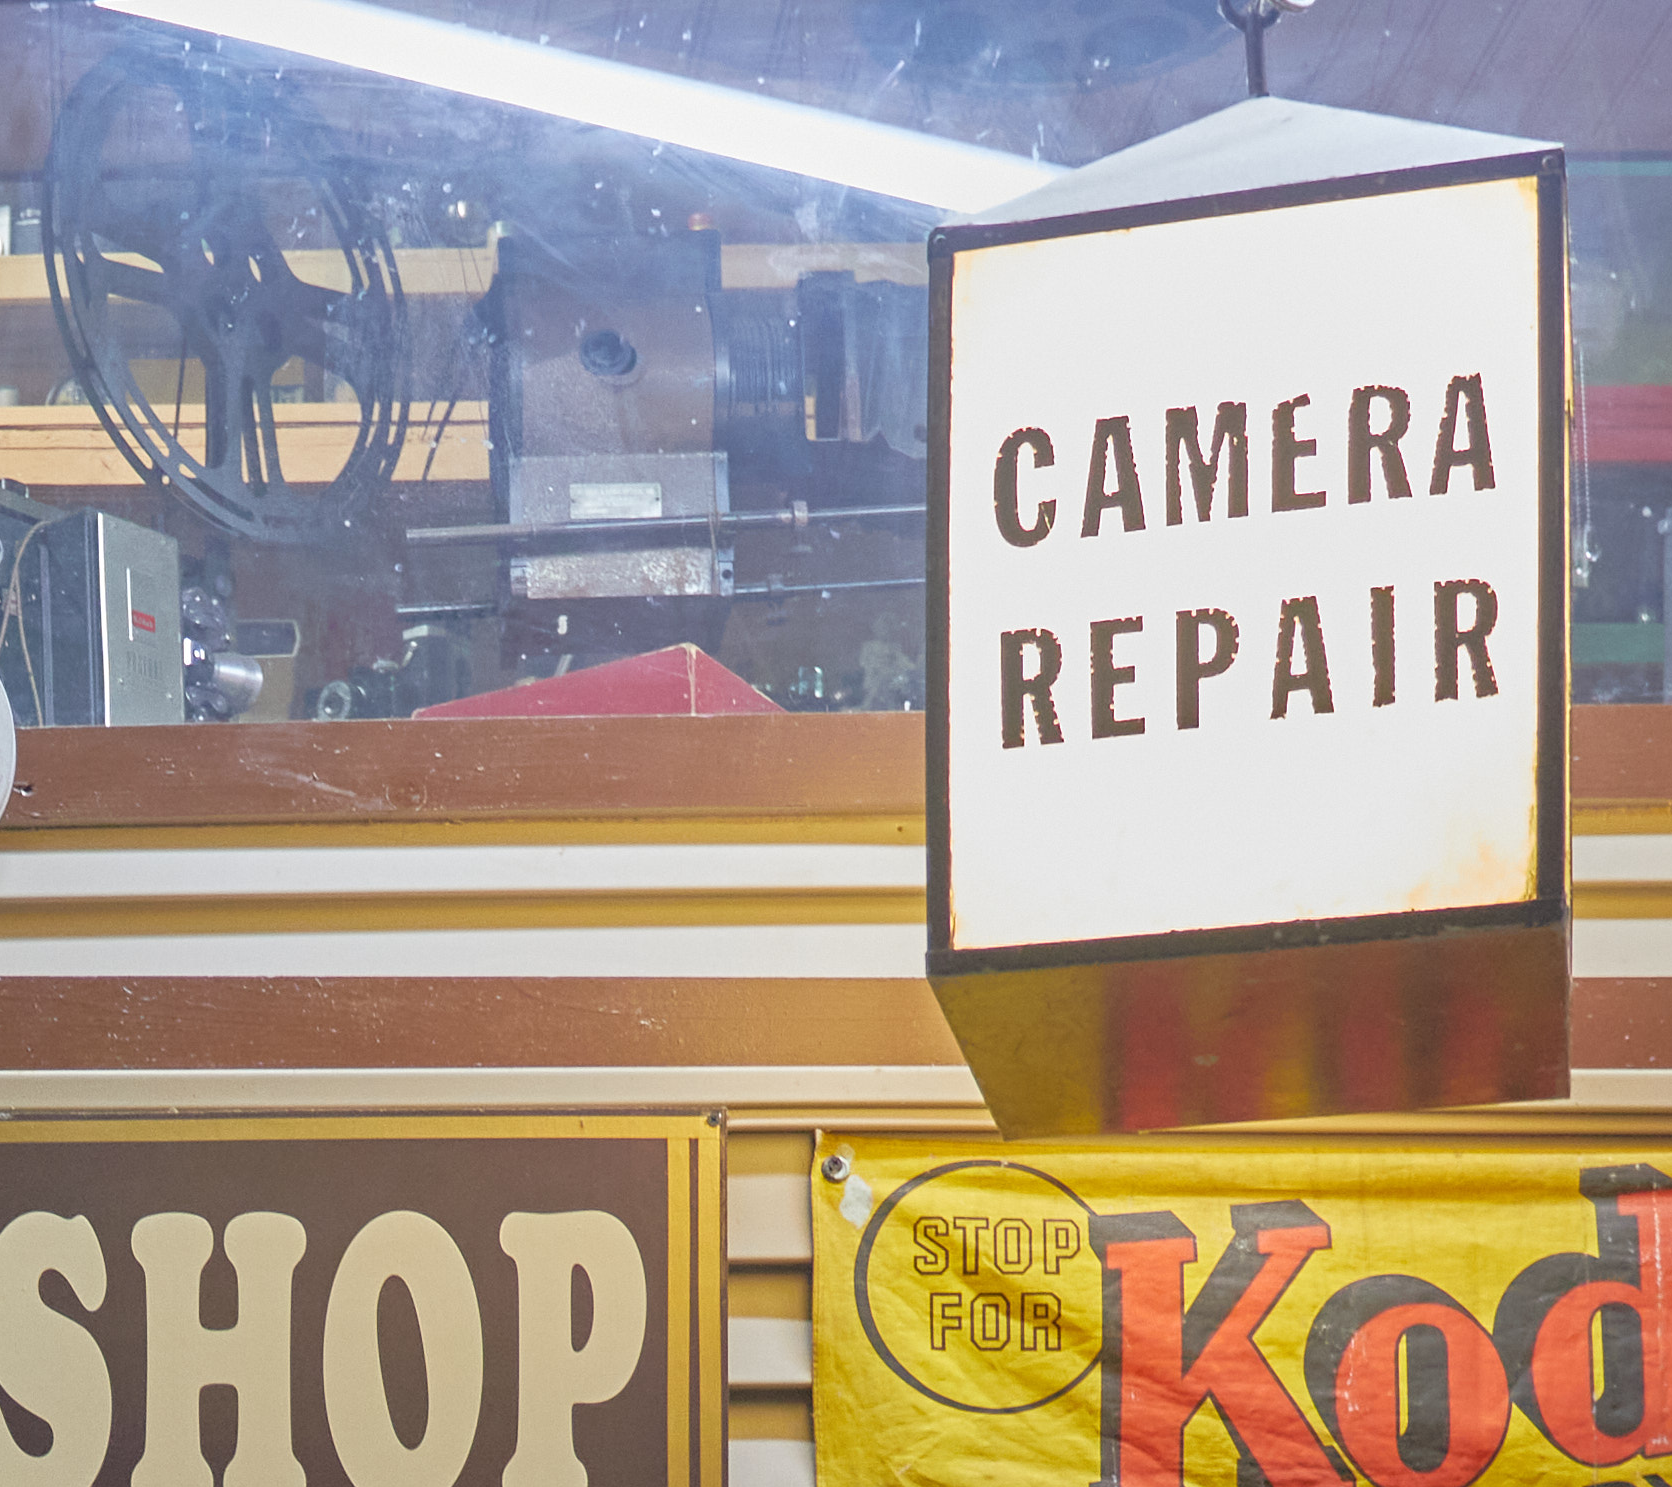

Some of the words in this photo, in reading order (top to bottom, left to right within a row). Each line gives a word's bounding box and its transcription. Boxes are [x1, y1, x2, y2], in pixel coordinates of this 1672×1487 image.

[992, 372, 1496, 549] CAMERA
[1000, 577, 1500, 750] REPAIR
[913, 1215, 1084, 1279] STOP
[928, 1290, 1065, 1353] FOR
